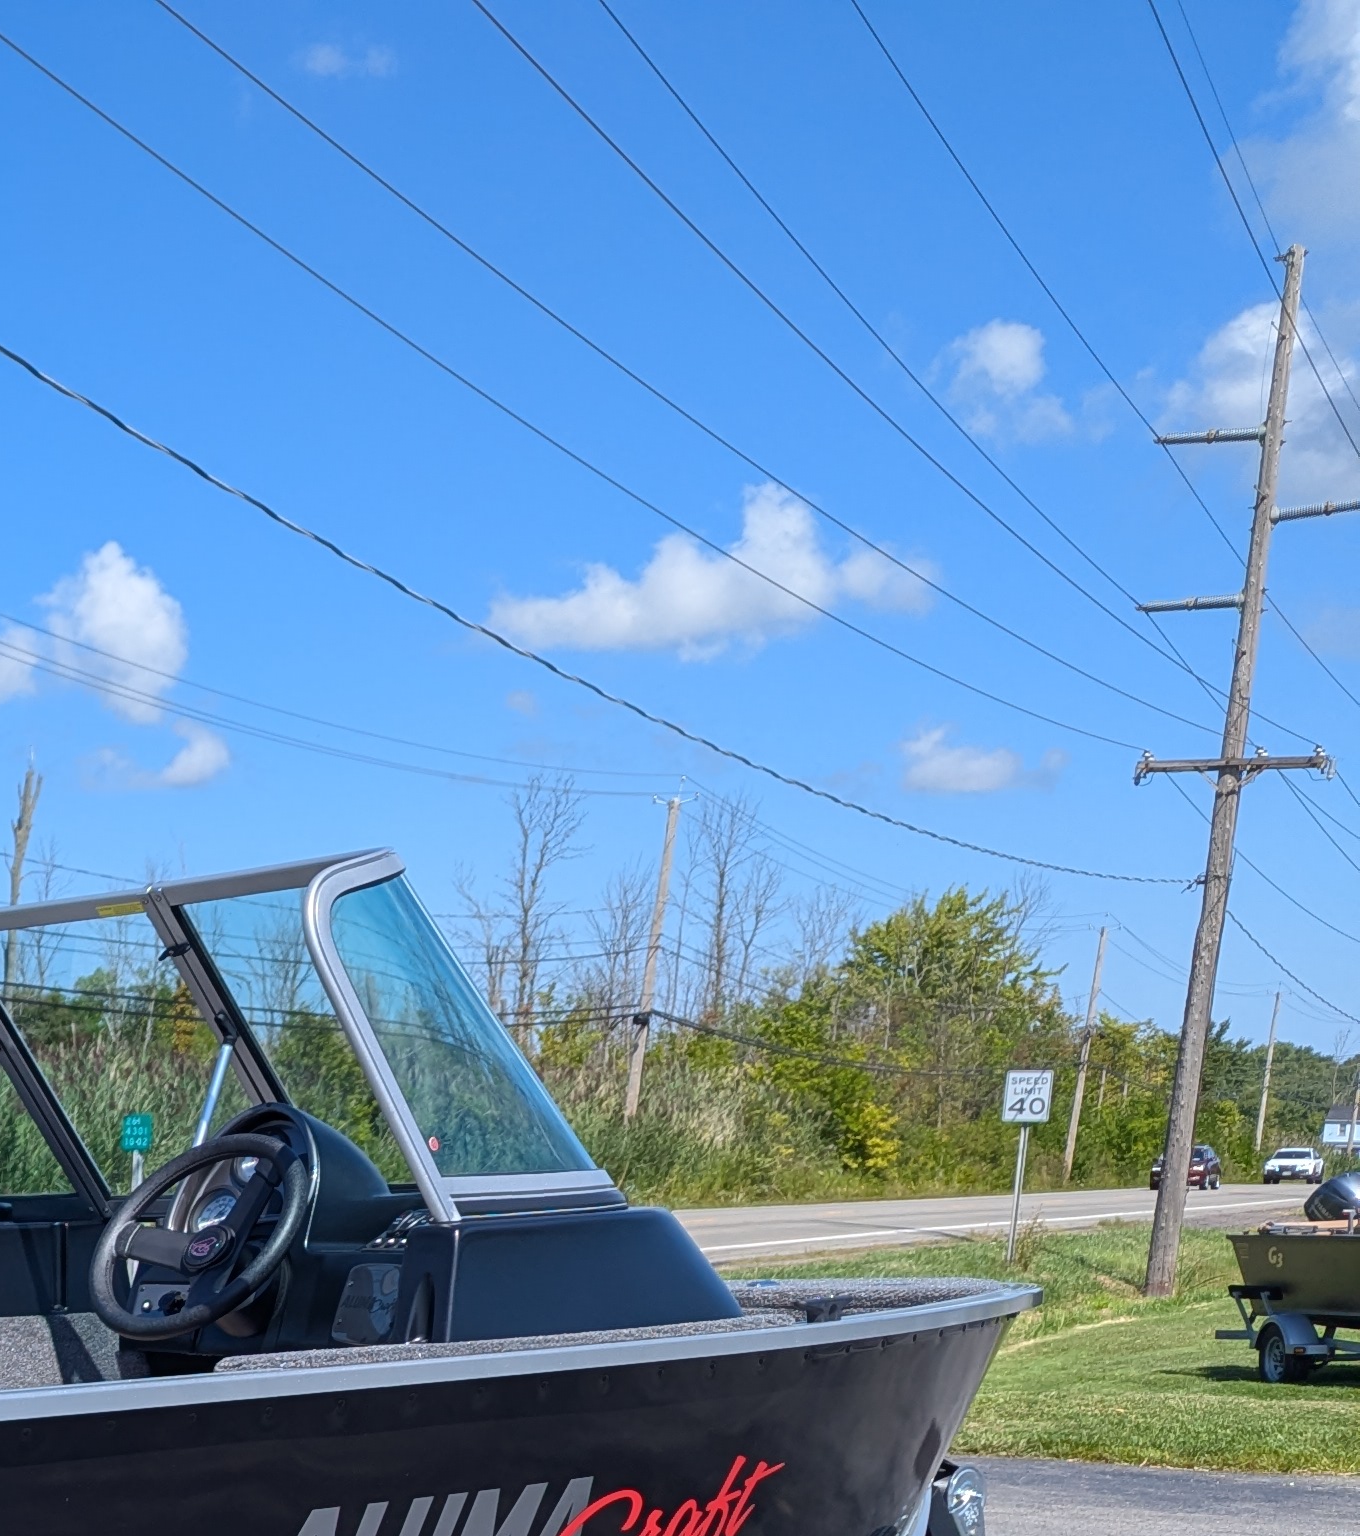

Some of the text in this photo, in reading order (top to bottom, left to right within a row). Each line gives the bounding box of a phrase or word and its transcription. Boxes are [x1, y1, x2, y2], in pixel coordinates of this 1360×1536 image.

[1011, 1076, 1049, 1085] SPEED
[1013, 1087, 1043, 1095] LIMIT
[1007, 1097, 1046, 1115] 40
[1268, 1246, 1284, 1268] G3
